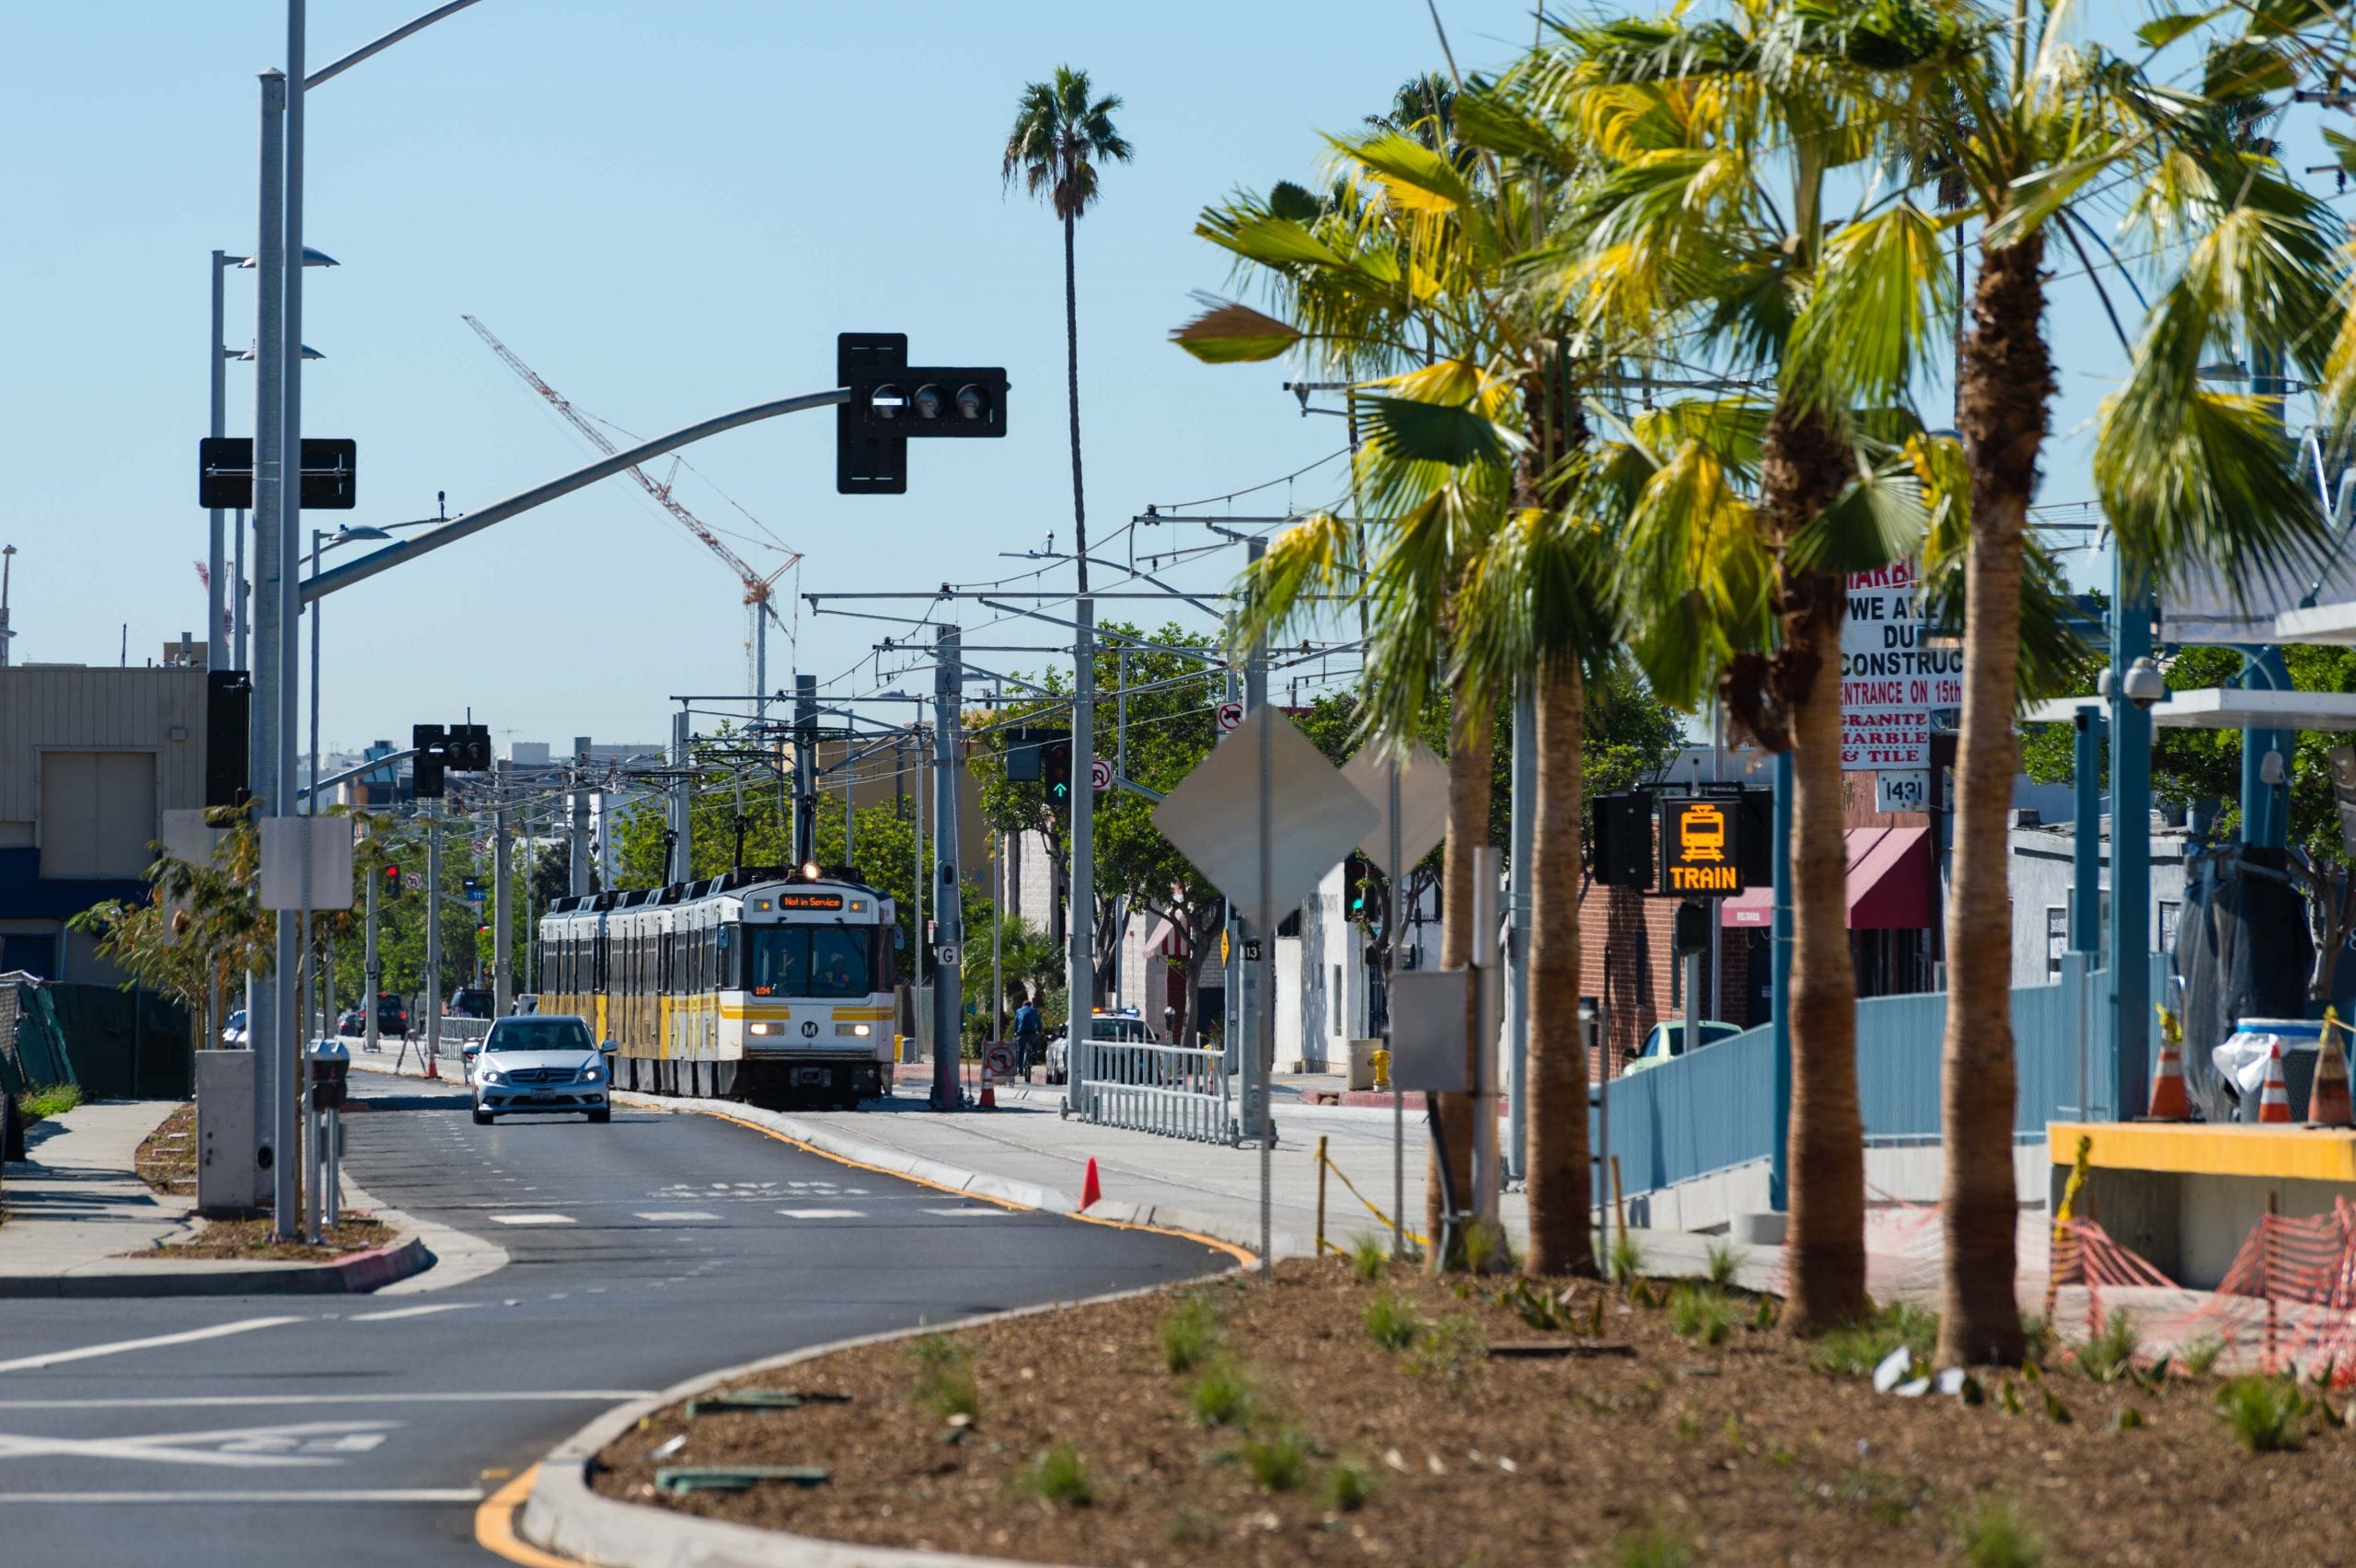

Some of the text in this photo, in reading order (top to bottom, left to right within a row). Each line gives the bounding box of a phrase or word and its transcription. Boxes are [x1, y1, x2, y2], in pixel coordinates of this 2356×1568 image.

[1848, 558, 1921, 589] ARBL
[1850, 596, 1939, 620] WE ARE
[1884, 625, 1915, 649] DU
[1841, 651, 1964, 676] CONSTRUC
[1911, 680, 1928, 703] ON
[1935, 679, 1962, 703] 15th
[1842, 750, 1920, 763] & TILE
[1669, 866, 1737, 890] TRAIN
[785, 897, 840, 906] Not in Service
[943, 948, 953, 963] G
[1247, 947, 1257, 958] 13
[755, 986, 770, 995] 104
[803, 1022, 817, 1037] M
